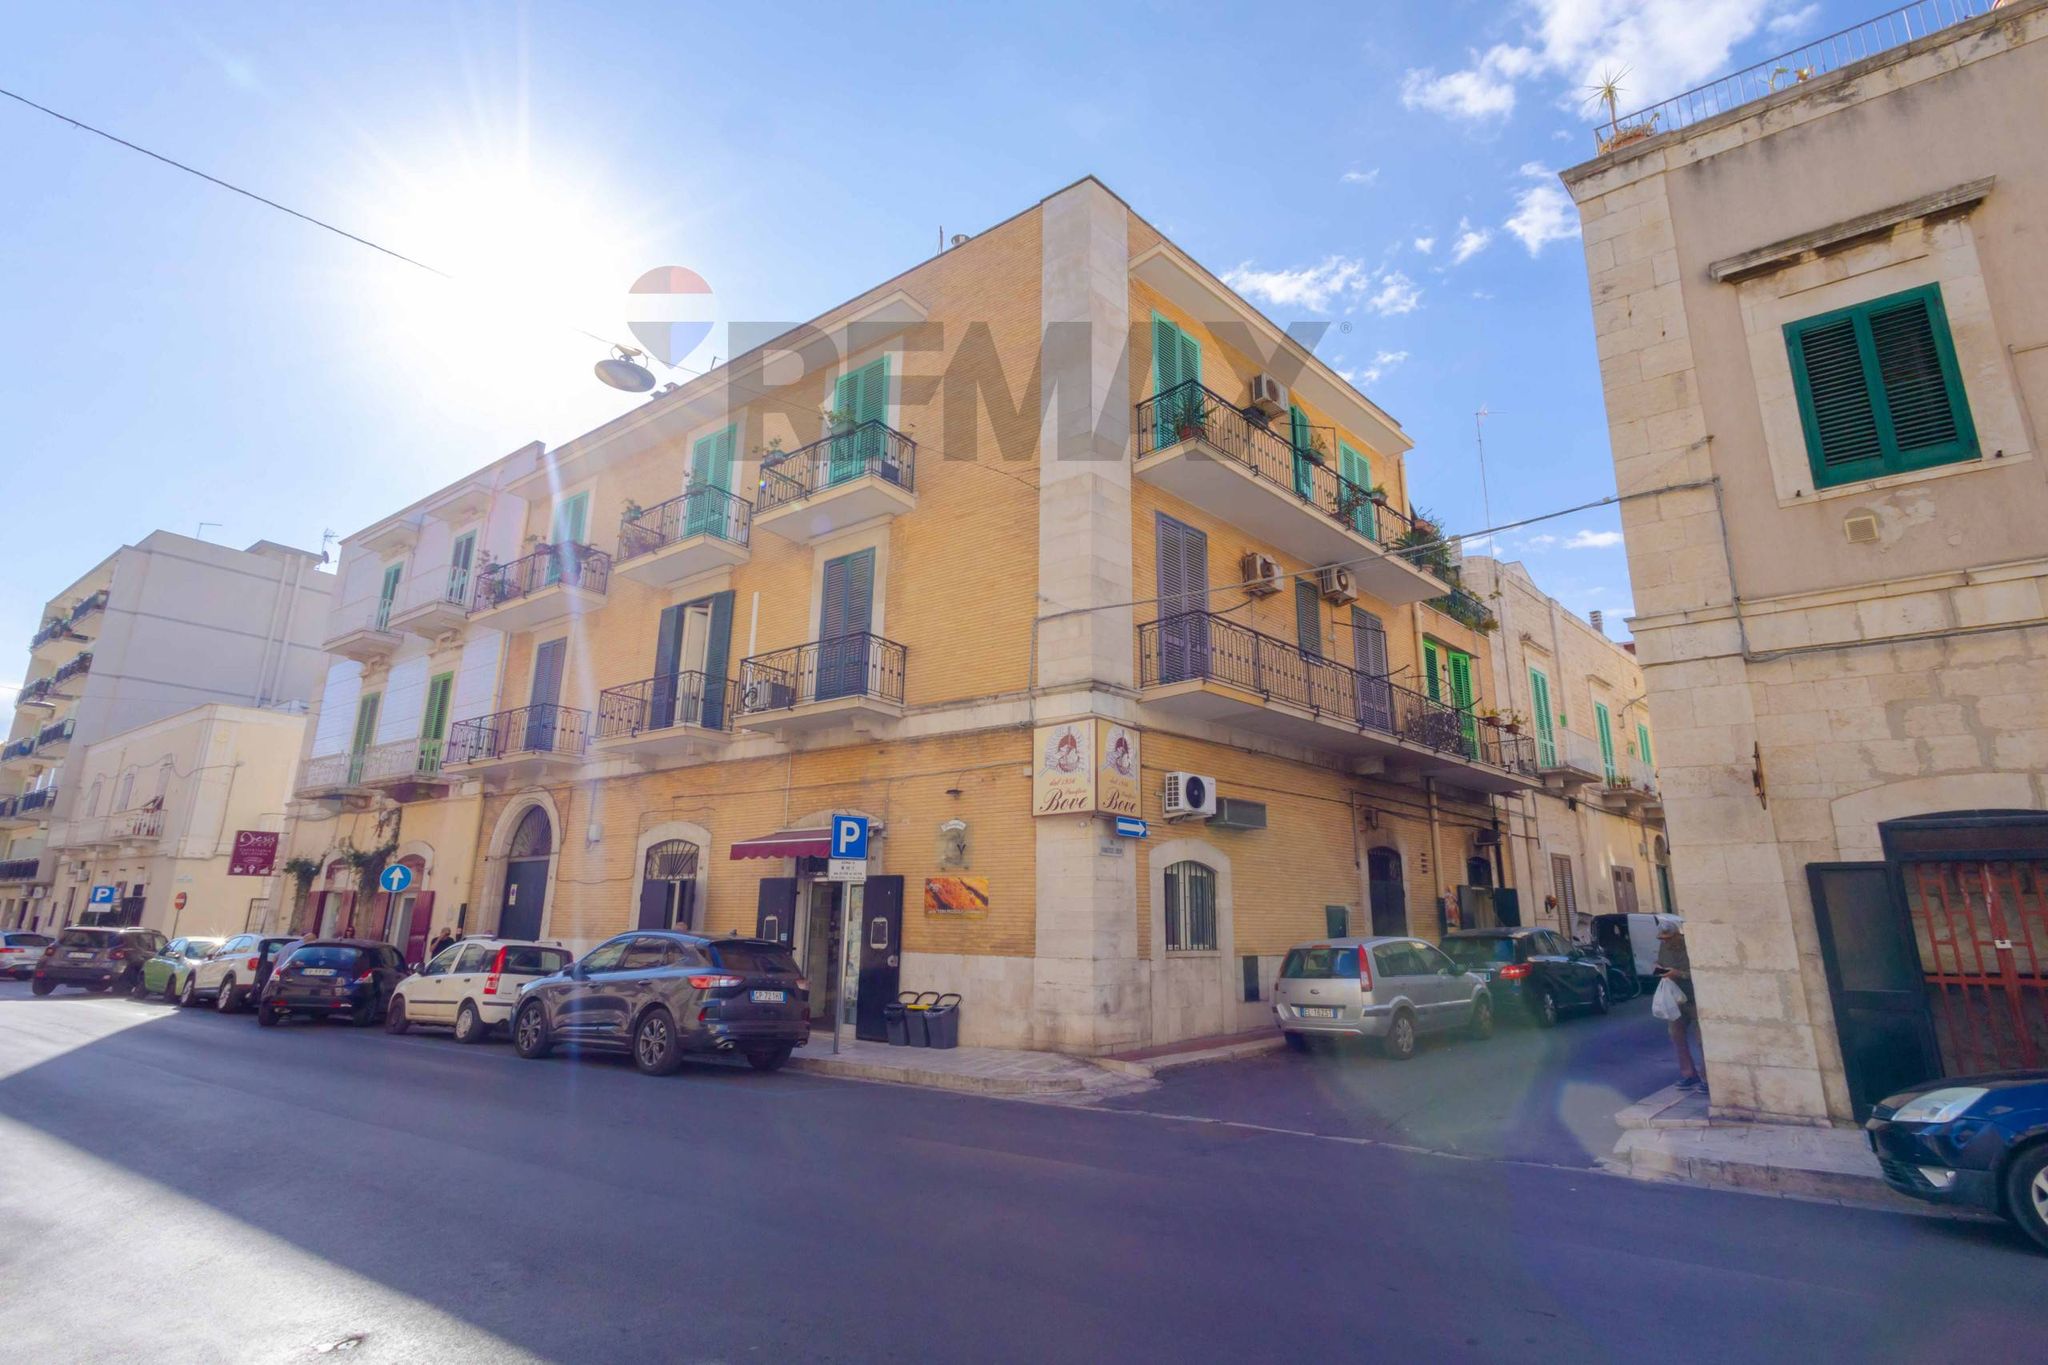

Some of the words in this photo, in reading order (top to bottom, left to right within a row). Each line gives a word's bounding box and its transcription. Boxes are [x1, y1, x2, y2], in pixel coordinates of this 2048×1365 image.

[1039, 787, 1088, 812] Bove
[1102, 787, 1137, 814] Bove
[839, 820, 861, 854] P
[95, 887, 111, 902] P
